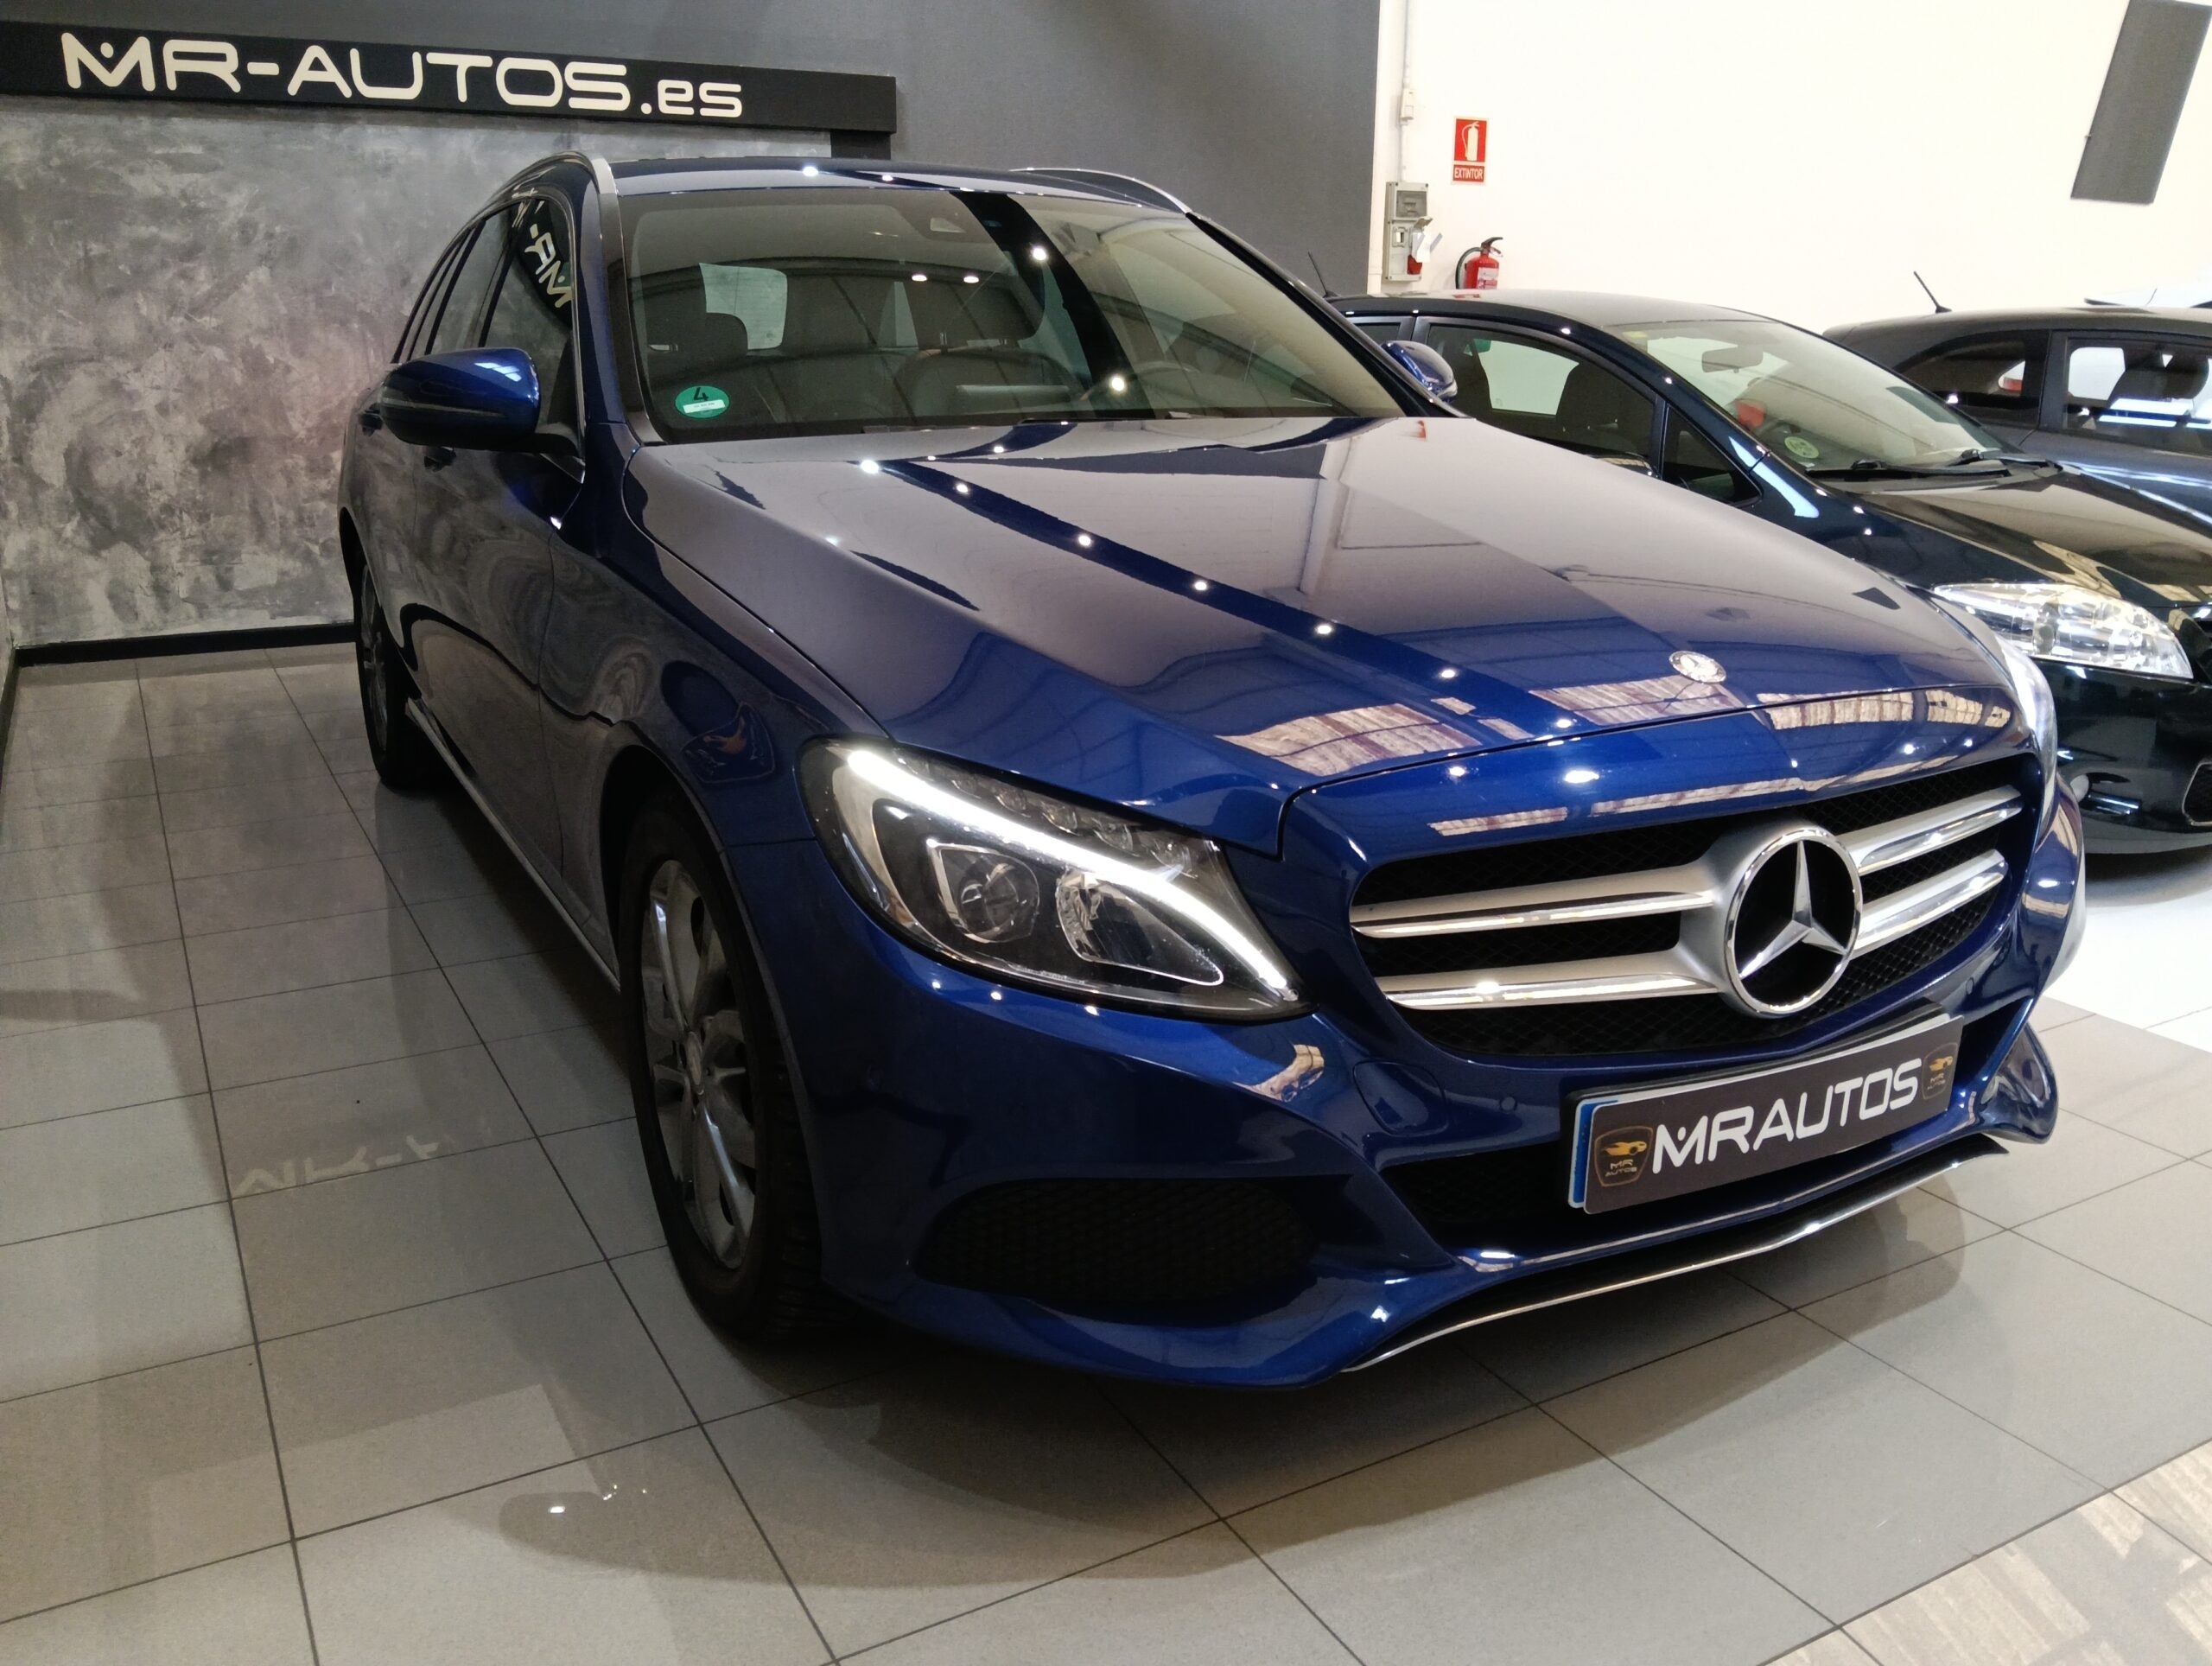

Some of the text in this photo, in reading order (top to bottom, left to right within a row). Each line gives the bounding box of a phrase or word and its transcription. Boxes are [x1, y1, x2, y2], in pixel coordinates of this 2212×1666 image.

[61, 32, 743, 119] MR-AUTOS.es
[1454, 167, 1484, 180] EXTINTOR
[693, 386, 709, 402] 4
